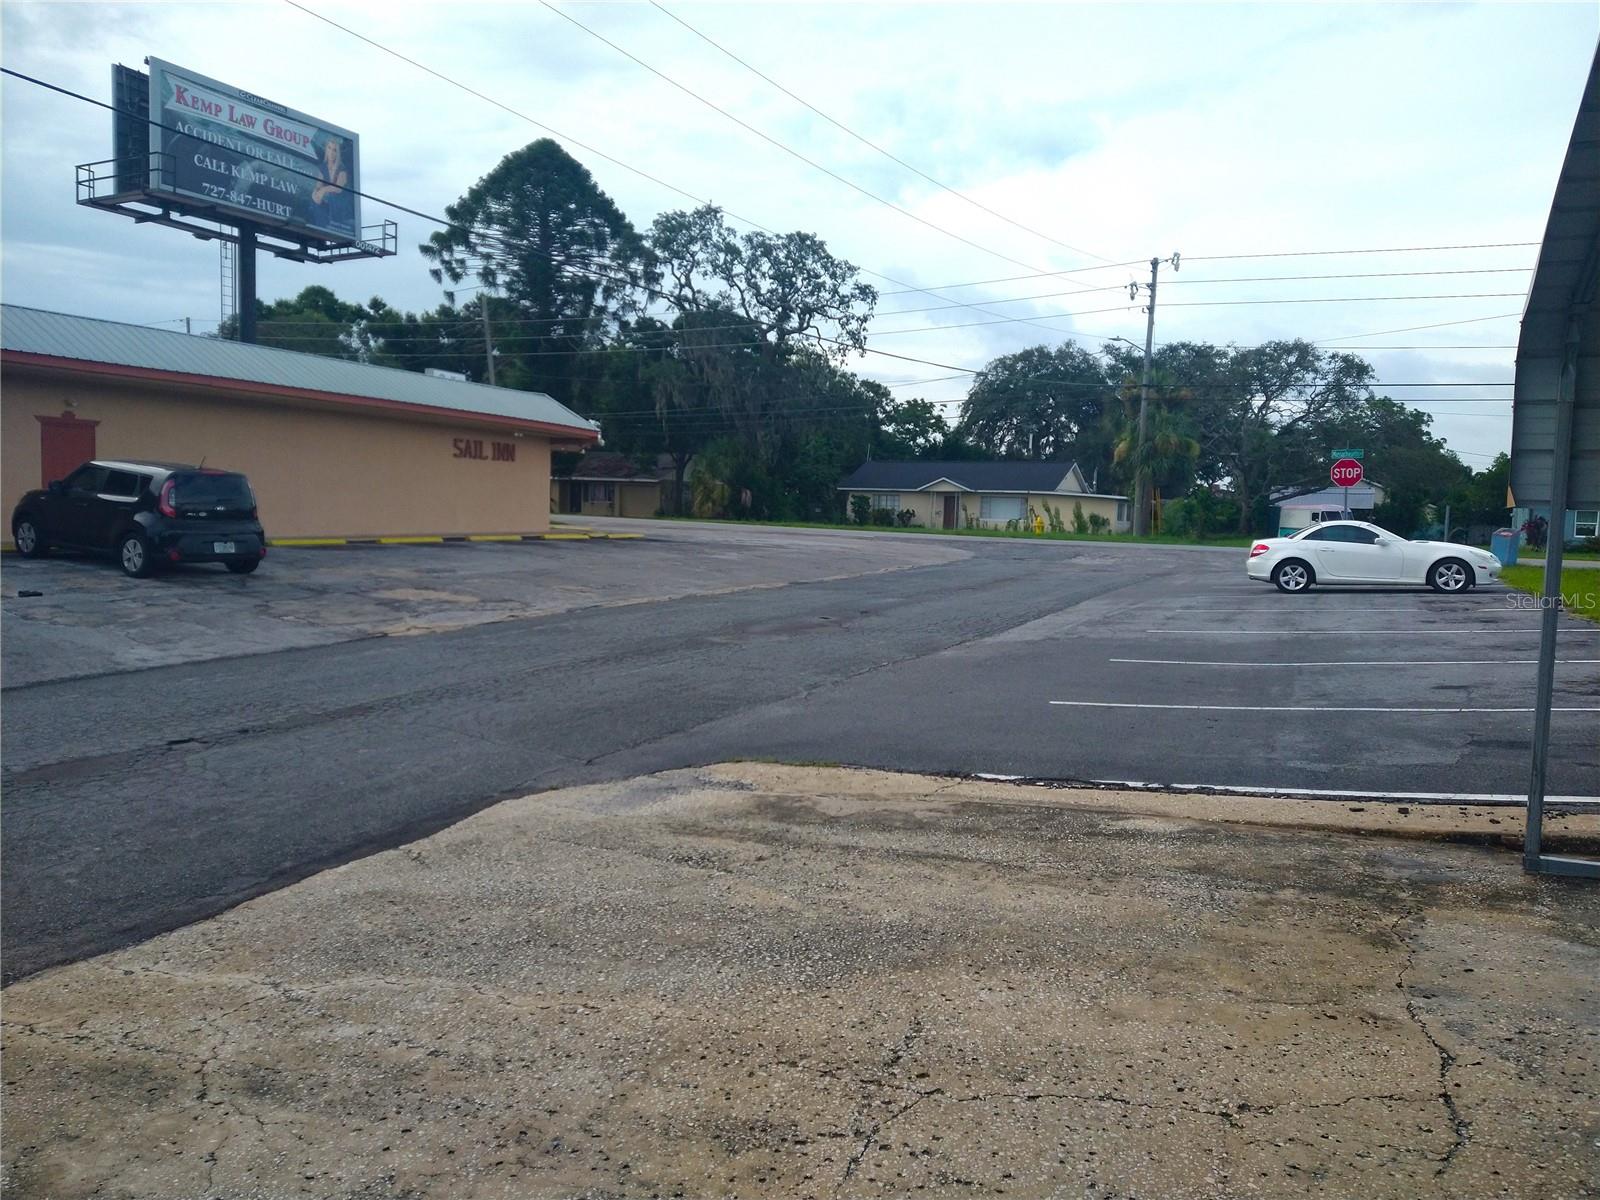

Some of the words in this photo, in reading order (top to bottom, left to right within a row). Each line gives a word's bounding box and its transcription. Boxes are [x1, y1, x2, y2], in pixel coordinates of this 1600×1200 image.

[175, 84, 222, 117] KEMP
[228, 104, 257, 129] LAW
[263, 118, 310, 148] GROUP
[176, 121, 241, 152] ACCIDENT
[246, 145, 263, 160] OR
[194, 154, 228, 174] CALL
[231, 164, 268, 185] KEMP
[271, 177, 298, 194] LAW
[201, 182, 292, 217] 727-847-HURT
[453, 438, 488, 460] SAIL
[491, 442, 516, 461] INN
[1333, 467, 1360, 479] STOP
